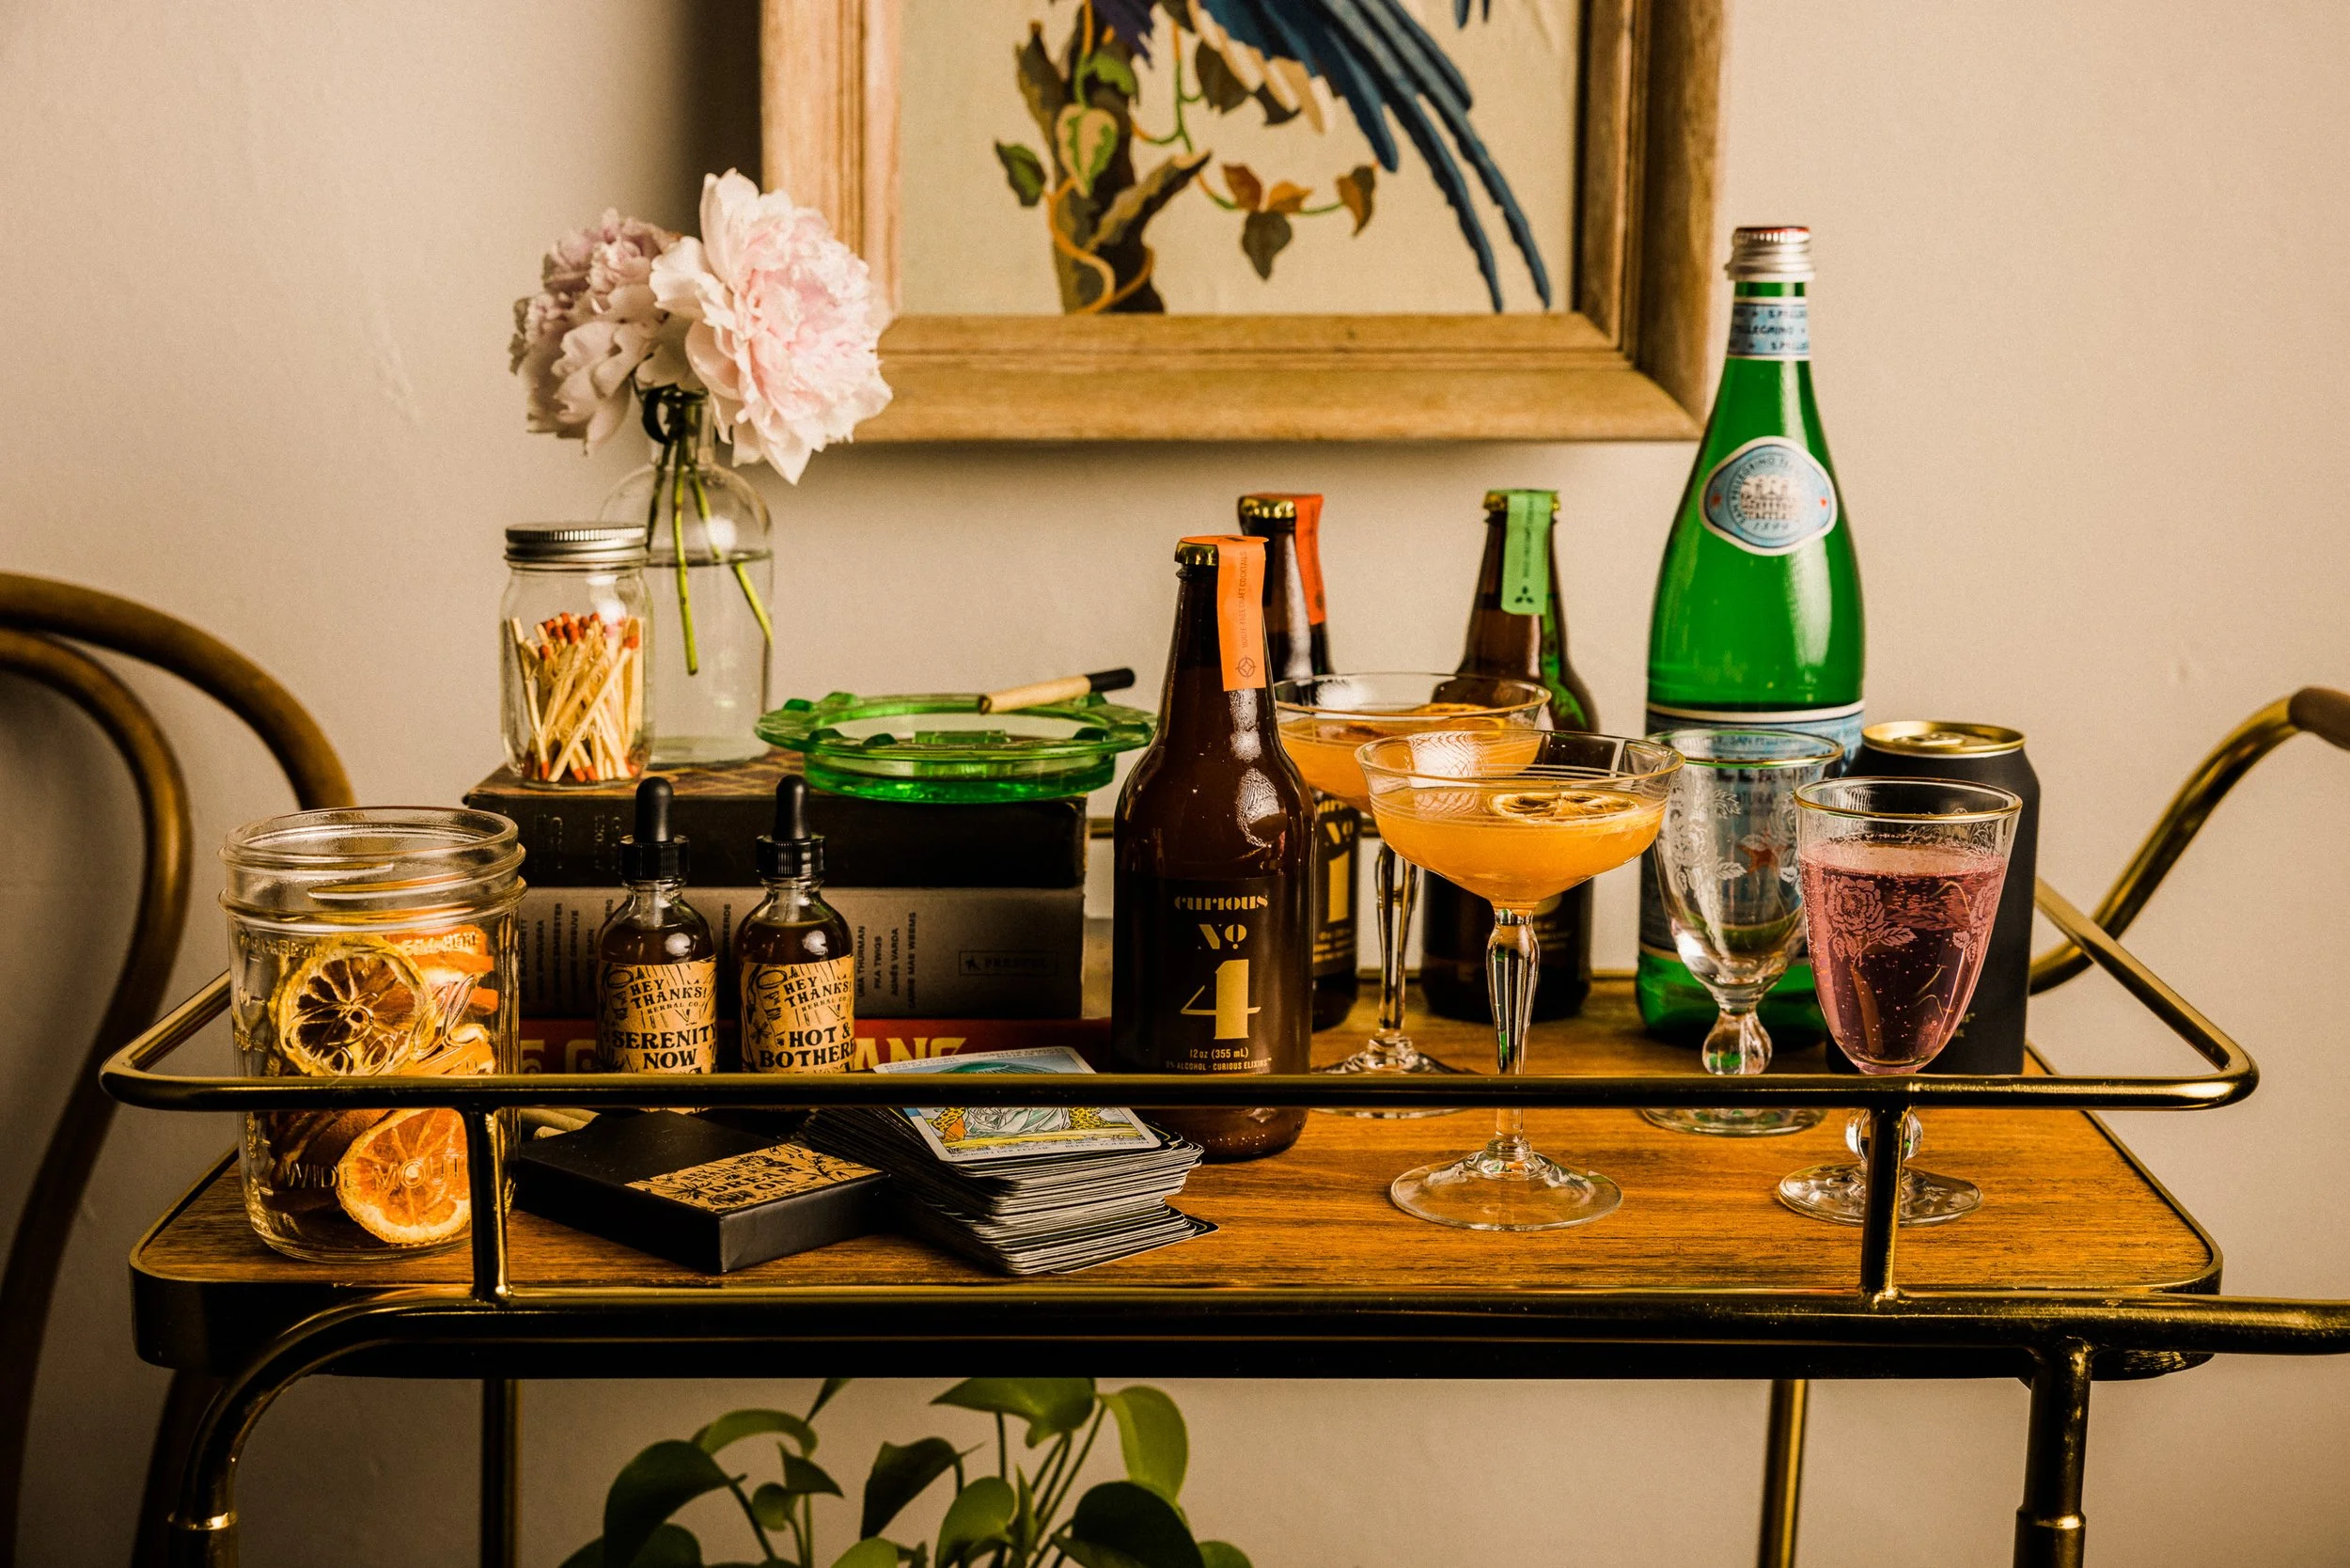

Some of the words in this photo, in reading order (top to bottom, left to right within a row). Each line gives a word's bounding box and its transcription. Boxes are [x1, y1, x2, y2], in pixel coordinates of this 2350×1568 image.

[1174, 895, 1268, 911] curious
[857, 925, 866, 974] THURMAN
[890, 928, 900, 961] VARDA
[630, 979, 665, 996] HEY
[783, 976, 817, 995] HEY
[631, 986, 707, 1009] THANKS!
[1181, 959, 1261, 1040] 4
[789, 1027, 838, 1048] HOT
[841, 1022, 851, 1040] &
[643, 1048, 697, 1070] NOW
[1189, 1048, 1198, 1058] 12
[1211, 1047, 1231, 1059] (355
[1177, 1061, 1207, 1071] ALCOHOL
[1213, 1061, 1243, 1071] CURIOUS
[373, 1155, 462, 1190] MOUT
[708, 1166, 803, 1193] DREAM
[753, 1177, 795, 1191] ON
